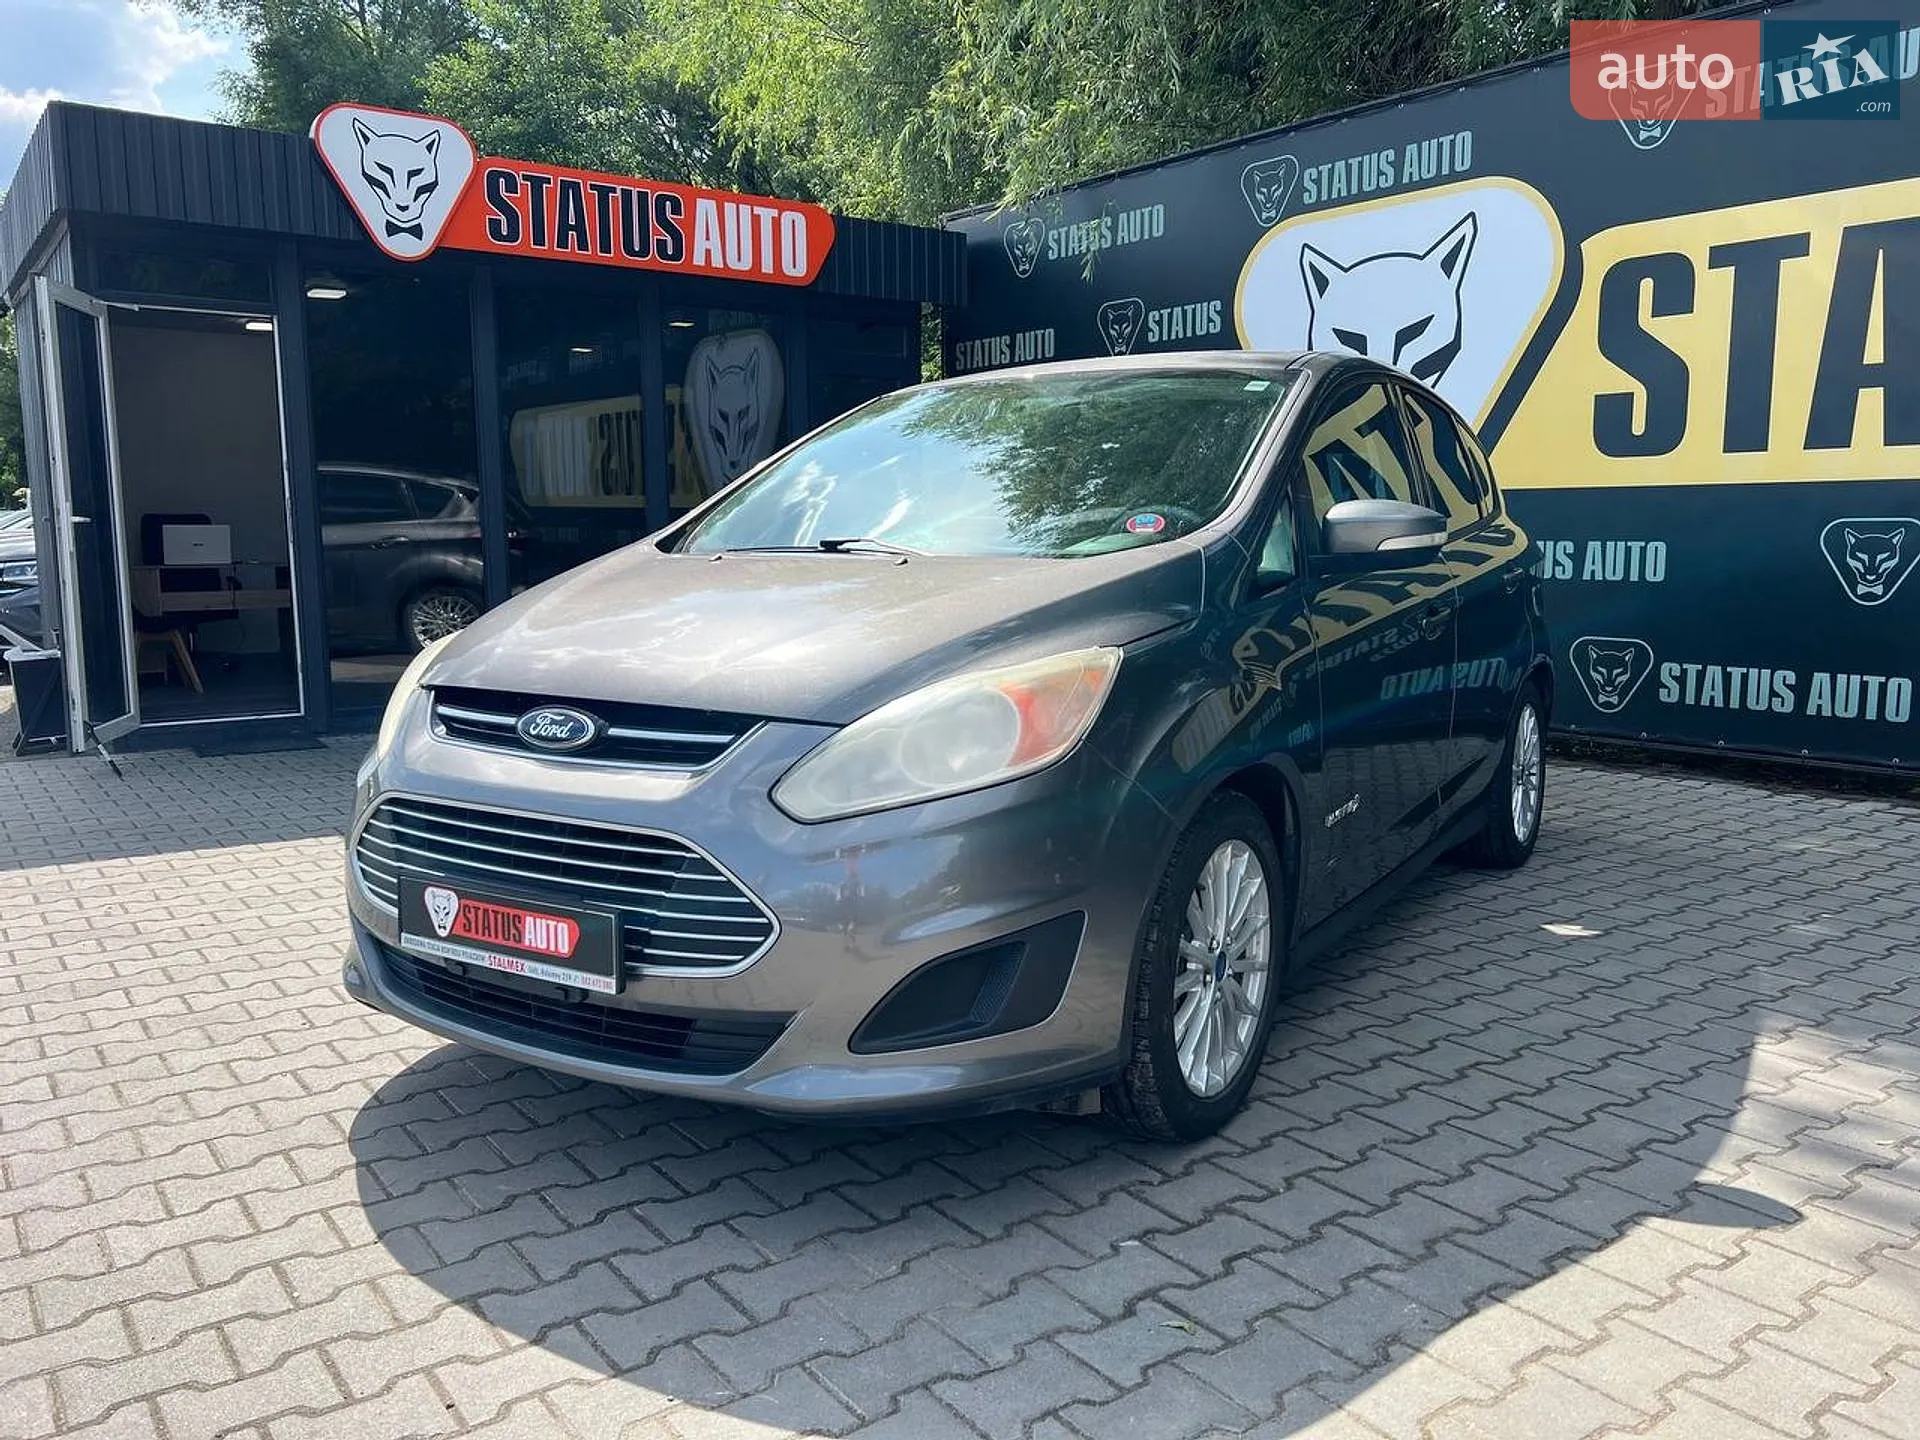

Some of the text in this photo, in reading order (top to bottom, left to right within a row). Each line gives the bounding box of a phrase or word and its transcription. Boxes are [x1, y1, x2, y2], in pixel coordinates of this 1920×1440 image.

[1302, 130, 1473, 205] STATUS AUTO
[484, 167, 808, 278] STATUS AUTO
[1115, 204, 1165, 246] AUTO
[1147, 300, 1222, 343] STATUS
[955, 327, 1056, 371] STATUS AUTO
[1582, 540, 1667, 582] AUTO
[1658, 661, 1913, 723] STATUS AUTO
[529, 712, 574, 738] Ford
[463, 904, 522, 943] STATUS
[525, 916, 569, 954] AUTO
